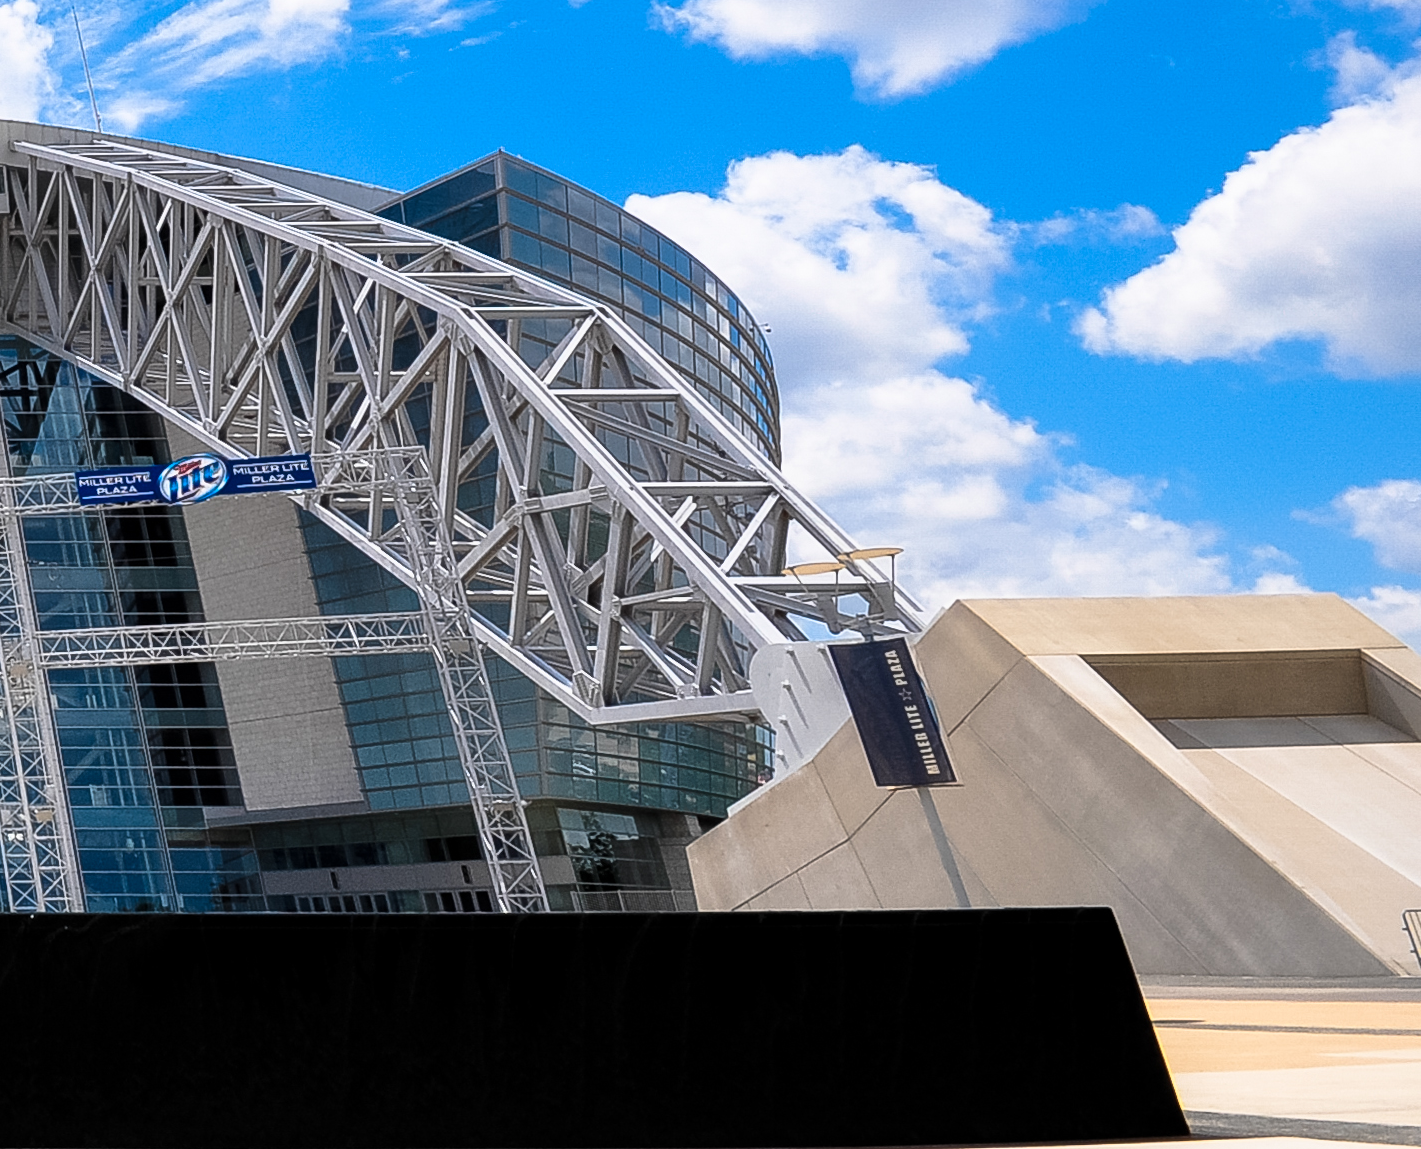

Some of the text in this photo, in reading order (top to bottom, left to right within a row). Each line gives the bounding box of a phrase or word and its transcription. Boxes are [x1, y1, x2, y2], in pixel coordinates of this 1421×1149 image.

[233, 462, 310, 476] MILLER LITE
[79, 474, 152, 487] MILLER LITE
[251, 473, 295, 484] PLAZA
[96, 485, 138, 495] PLAZA
[884, 649, 940, 775] MILLER LITE PLAZA
